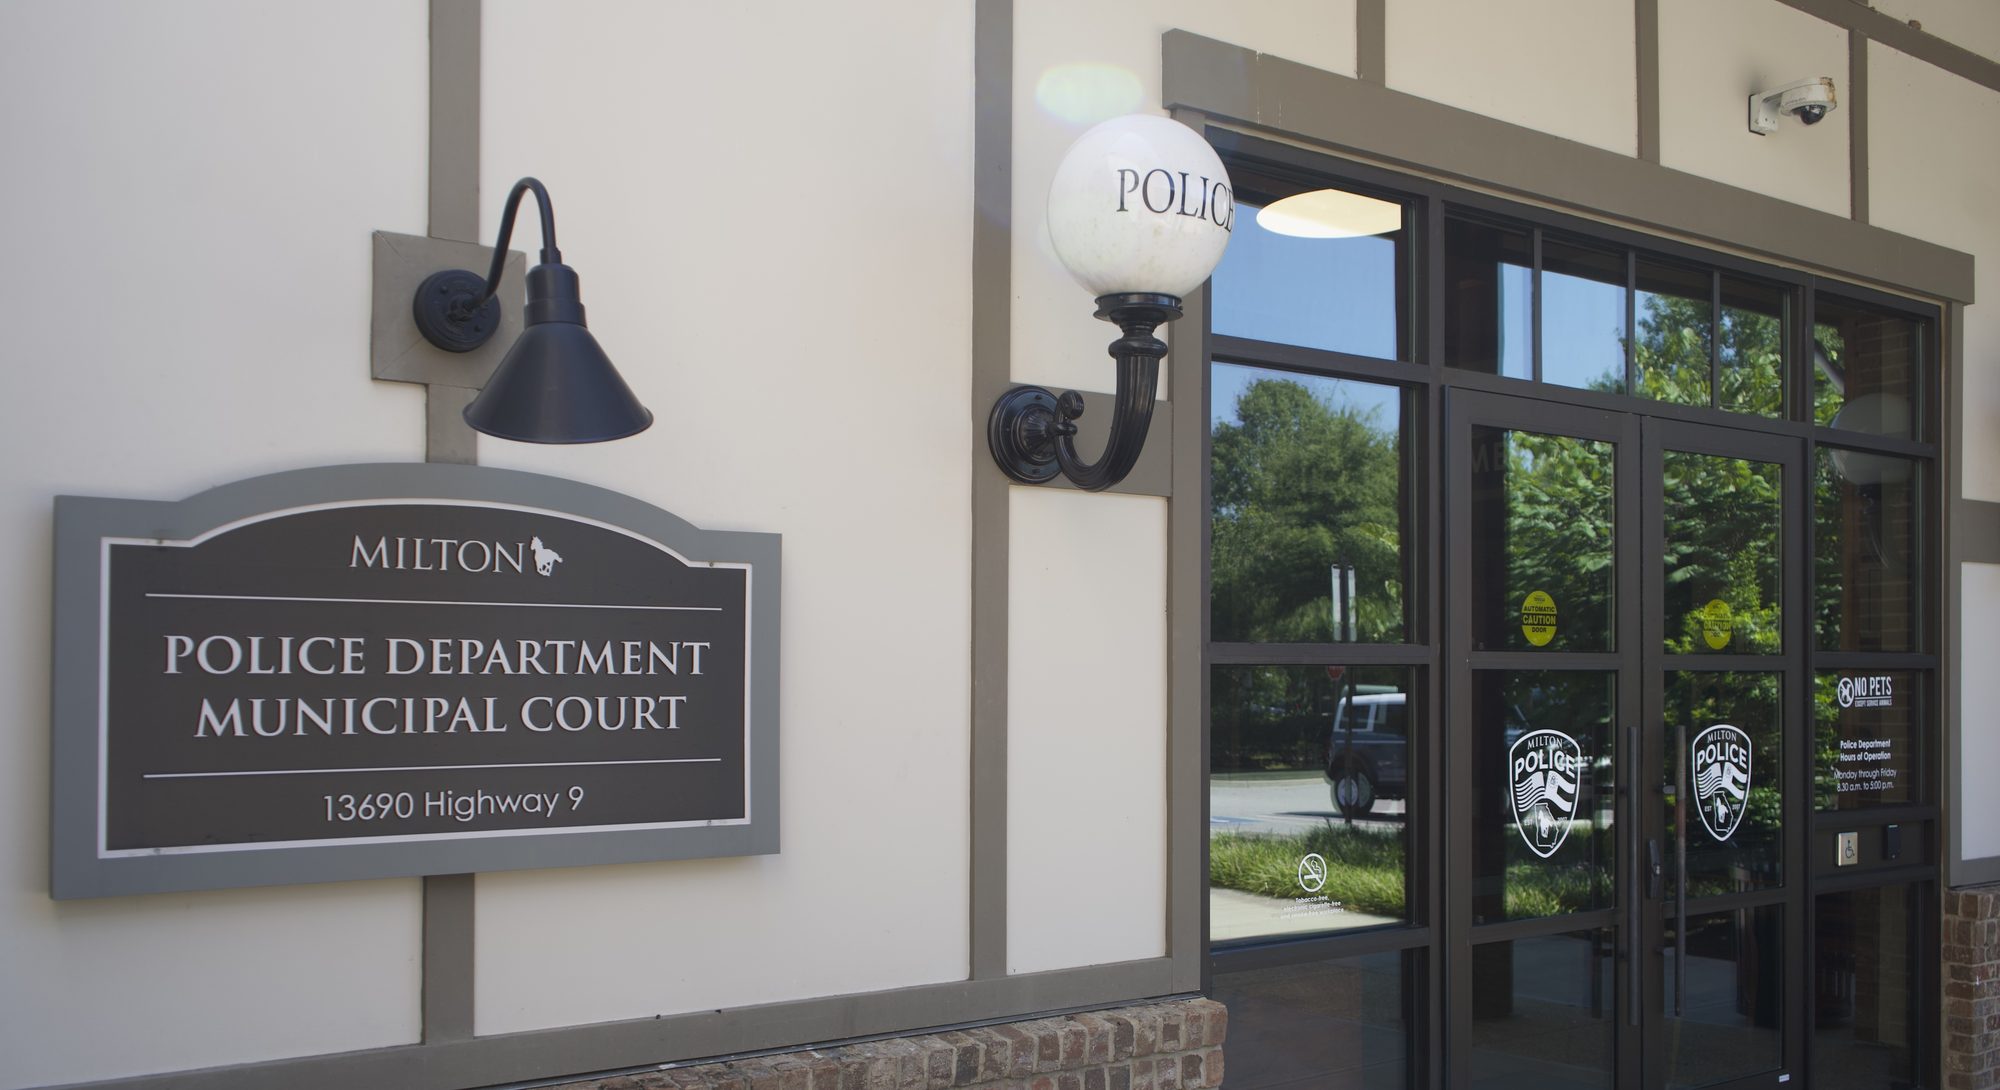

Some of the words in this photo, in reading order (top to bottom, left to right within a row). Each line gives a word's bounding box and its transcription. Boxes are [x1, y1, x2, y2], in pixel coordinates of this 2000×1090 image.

[349, 534, 526, 573] MILTON
[1523, 605, 1556, 613] AUTOMATIC
[1522, 614, 1556, 625] CAUTION
[163, 634, 366, 677] POLICE
[386, 638, 711, 676] DEPARTMENT
[1854, 677, 1867, 696] NO
[1869, 676, 1892, 696] PETS
[194, 695, 507, 738] MUNICIPAL
[521, 694, 687, 731] COURT
[1527, 735, 1563, 750] MILTON
[1706, 729, 1737, 743] MILTON
[1840, 740, 1857, 750] Police
[1858, 738, 1891, 750] Department
[1697, 741, 1747, 771] POLICE
[1840, 753, 1856, 762] Hours
[1856, 751, 1863, 761] of
[1863, 751, 1891, 762] Operation
[1515, 748, 1576, 781] POLICE
[1833, 768, 1858, 780] Monday
[1858, 768, 1880, 780] through
[1880, 767, 1897, 779] Friday
[1849, 783, 1862, 791] a.m.
[1863, 781, 1870, 790] to
[1869, 780, 1881, 790] 5:00
[1881, 781, 1894, 790] p.m.
[322, 790, 415, 822] 13690
[424, 787, 560, 823] Highway
[567, 785, 586, 812] 9
[1703, 805, 1713, 813] EST
